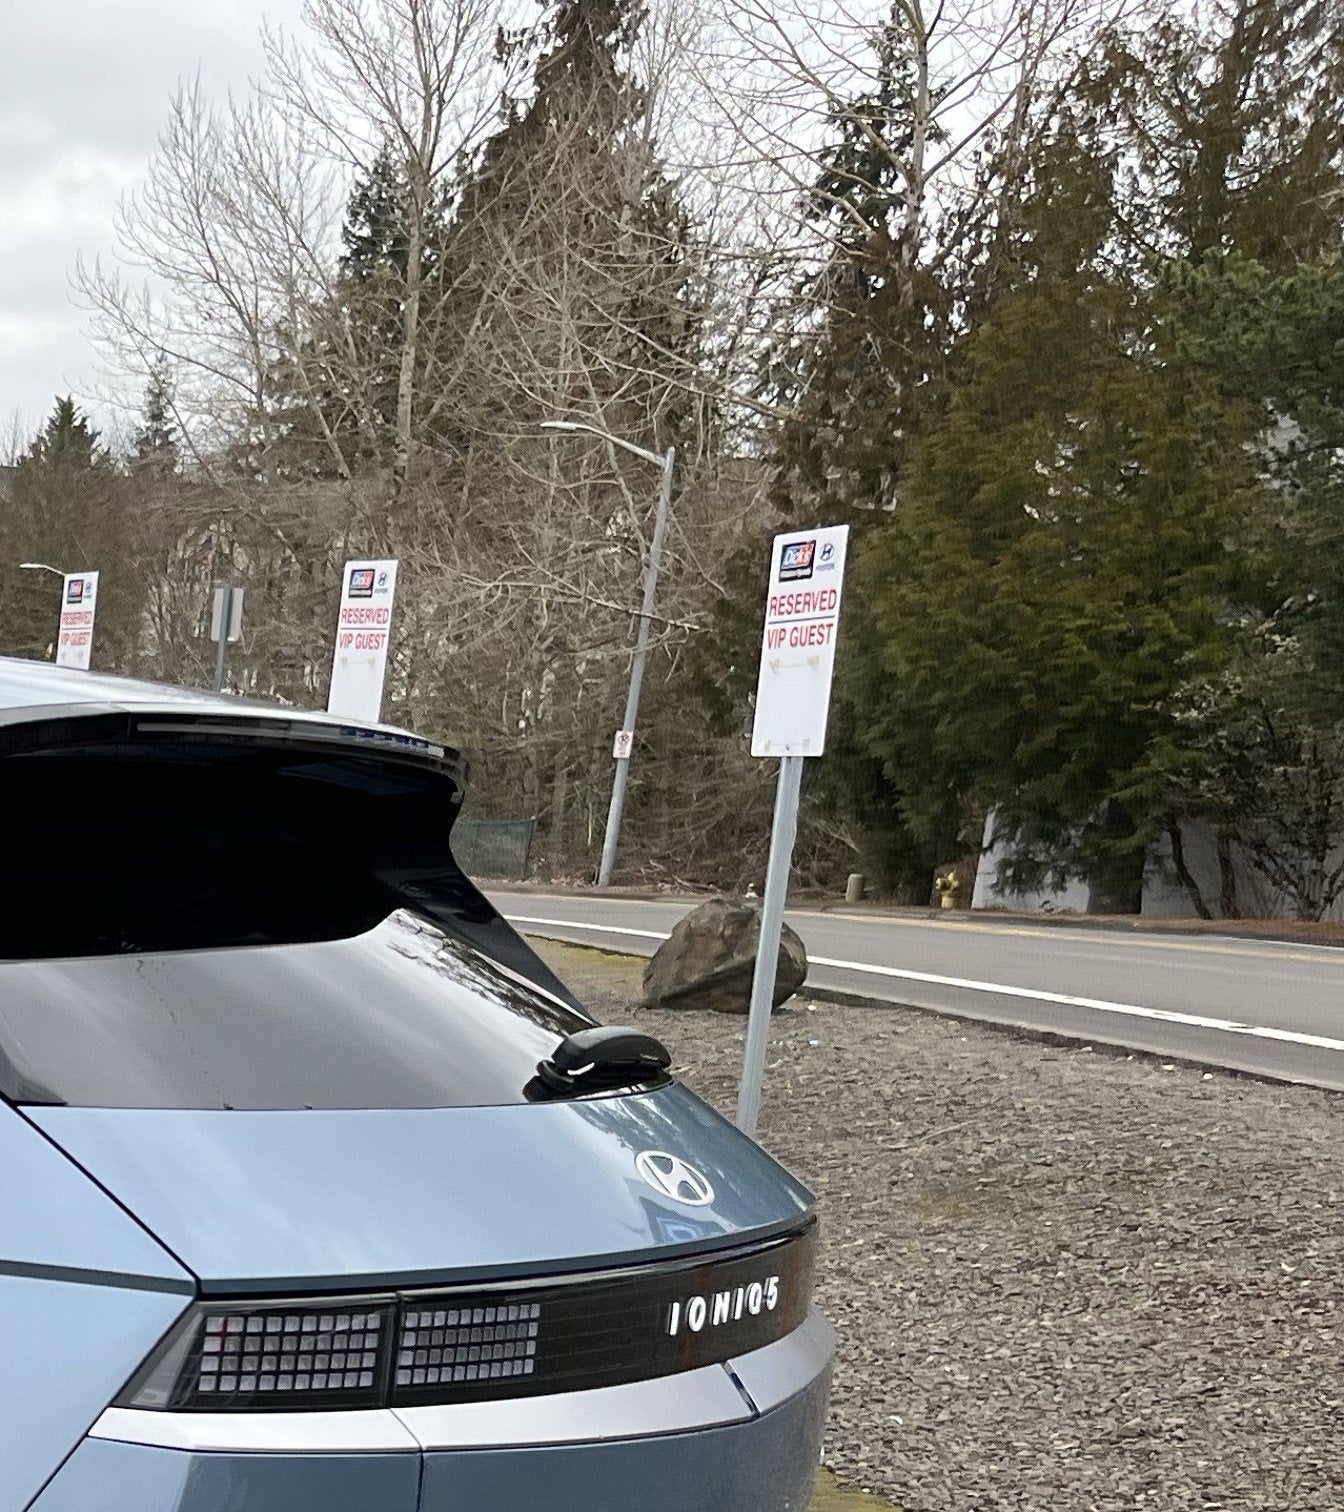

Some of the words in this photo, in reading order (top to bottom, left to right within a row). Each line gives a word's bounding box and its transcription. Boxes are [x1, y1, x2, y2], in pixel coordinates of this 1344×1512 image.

[769, 589, 837, 617] RESERVED
[341, 608, 389, 624] RESERVED
[339, 632, 353, 650] VIP
[355, 632, 386, 650] GUEST
[768, 628, 786, 650] VIP
[790, 623, 834, 648] GUEST
